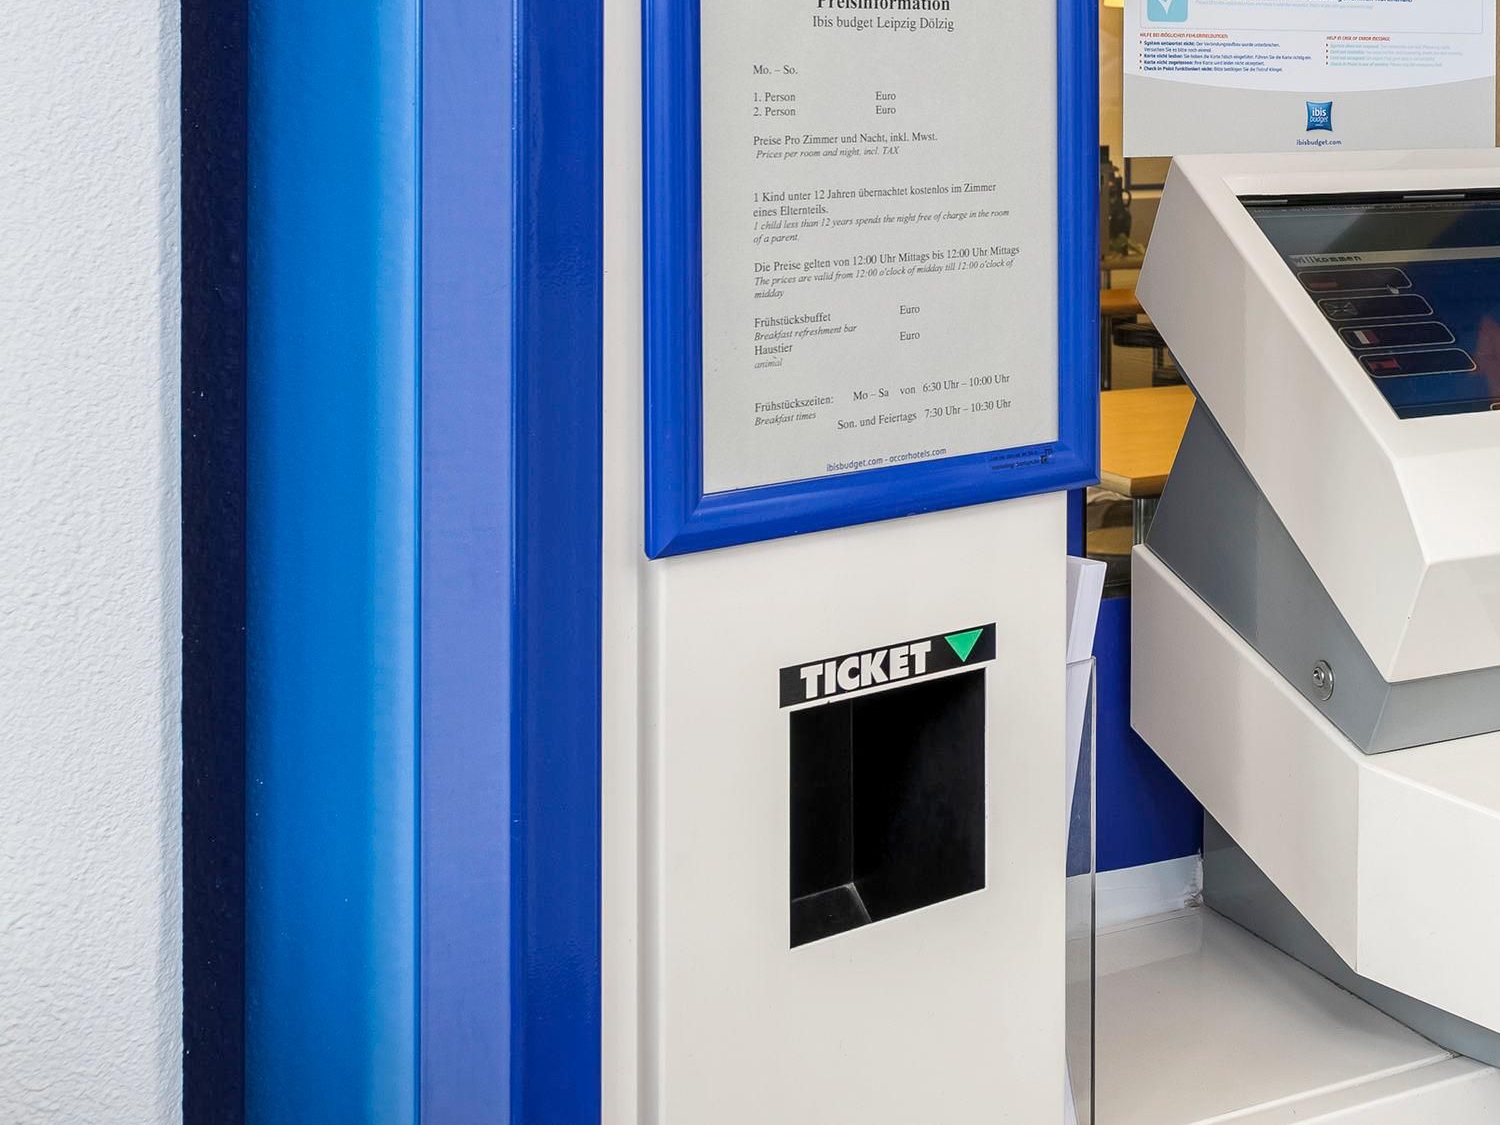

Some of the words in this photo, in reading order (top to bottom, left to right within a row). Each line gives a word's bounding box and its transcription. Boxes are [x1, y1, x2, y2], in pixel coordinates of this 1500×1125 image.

[812, 15, 833, 27] Ibis
[836, 16, 873, 30] budget
[876, 16, 916, 31] Leipzig
[919, 17, 954, 32] Dölzig
[753, 65, 772, 74] Mo.
[782, 64, 798, 74] So.
[753, 92, 761, 101] 1.
[764, 92, 796, 101] Person
[875, 91, 896, 100] Euro
[752, 106, 762, 116] 2.
[764, 106, 796, 116] Person
[875, 105, 896, 114] Euro
[1312, 107, 1327, 117] ibis
[753, 135, 781, 145] Preise
[784, 135, 800, 144] Pro
[802, 134, 838, 144] Zimmer
[840, 133, 857, 143] und
[859, 133, 887, 142] Nacht,
[889, 132, 909, 141] inkl.
[911, 132, 937, 141] Mwst.
[754, 192, 758, 202] 1
[762, 191, 785, 201] Kind
[787, 192, 811, 200] unter
[814, 189, 825, 199] 12
[826, 189, 856, 198] Jahren
[858, 187, 907, 197] übernachtet
[909, 185, 949, 194] kostenlos
[950, 183, 962, 192] im
[963, 183, 996, 192] Zimmer
[752, 207, 777, 216] eines
[780, 204, 829, 215] Elternteils.
[754, 262, 771, 272] Die
[773, 260, 801, 270] Preise
[803, 259, 830, 271] gelten
[853, 254, 877, 265] 12:00
[879, 253, 896, 263] Uhr
[898, 252, 930, 263] Mittags
[931, 250, 944, 259] bis
[947, 248, 970, 258] 12:00
[971, 247, 989, 256] Uhr
[989, 246, 1020, 258] Mittags
[899, 305, 920, 314] Euro
[754, 312, 831, 327] Frühstücksbuffet
[899, 331, 920, 340] Euro
[754, 343, 793, 355] Haustier
[922, 381, 941, 392] 6:30
[943, 380, 959, 389] Uhr
[969, 375, 992, 386] 10:00
[994, 374, 1010, 383] Uhr
[853, 390, 868, 400] Mo
[878, 388, 889, 397] Sa
[899, 386, 916, 394] von
[754, 396, 834, 412] Frühstückszeiten:
[924, 407, 943, 417] 7:30
[945, 405, 960, 415] Uhr
[971, 400, 994, 412] 10:30
[995, 399, 1011, 408] Uhr
[837, 419, 857, 429] Son.
[859, 415, 876, 426] und
[878, 413, 917, 423] Feiertags
[826, 458, 883, 471] ibisbudget.com
[888, 448, 949, 462] accorhotels.com
[800, 640, 931, 699] TICKET
